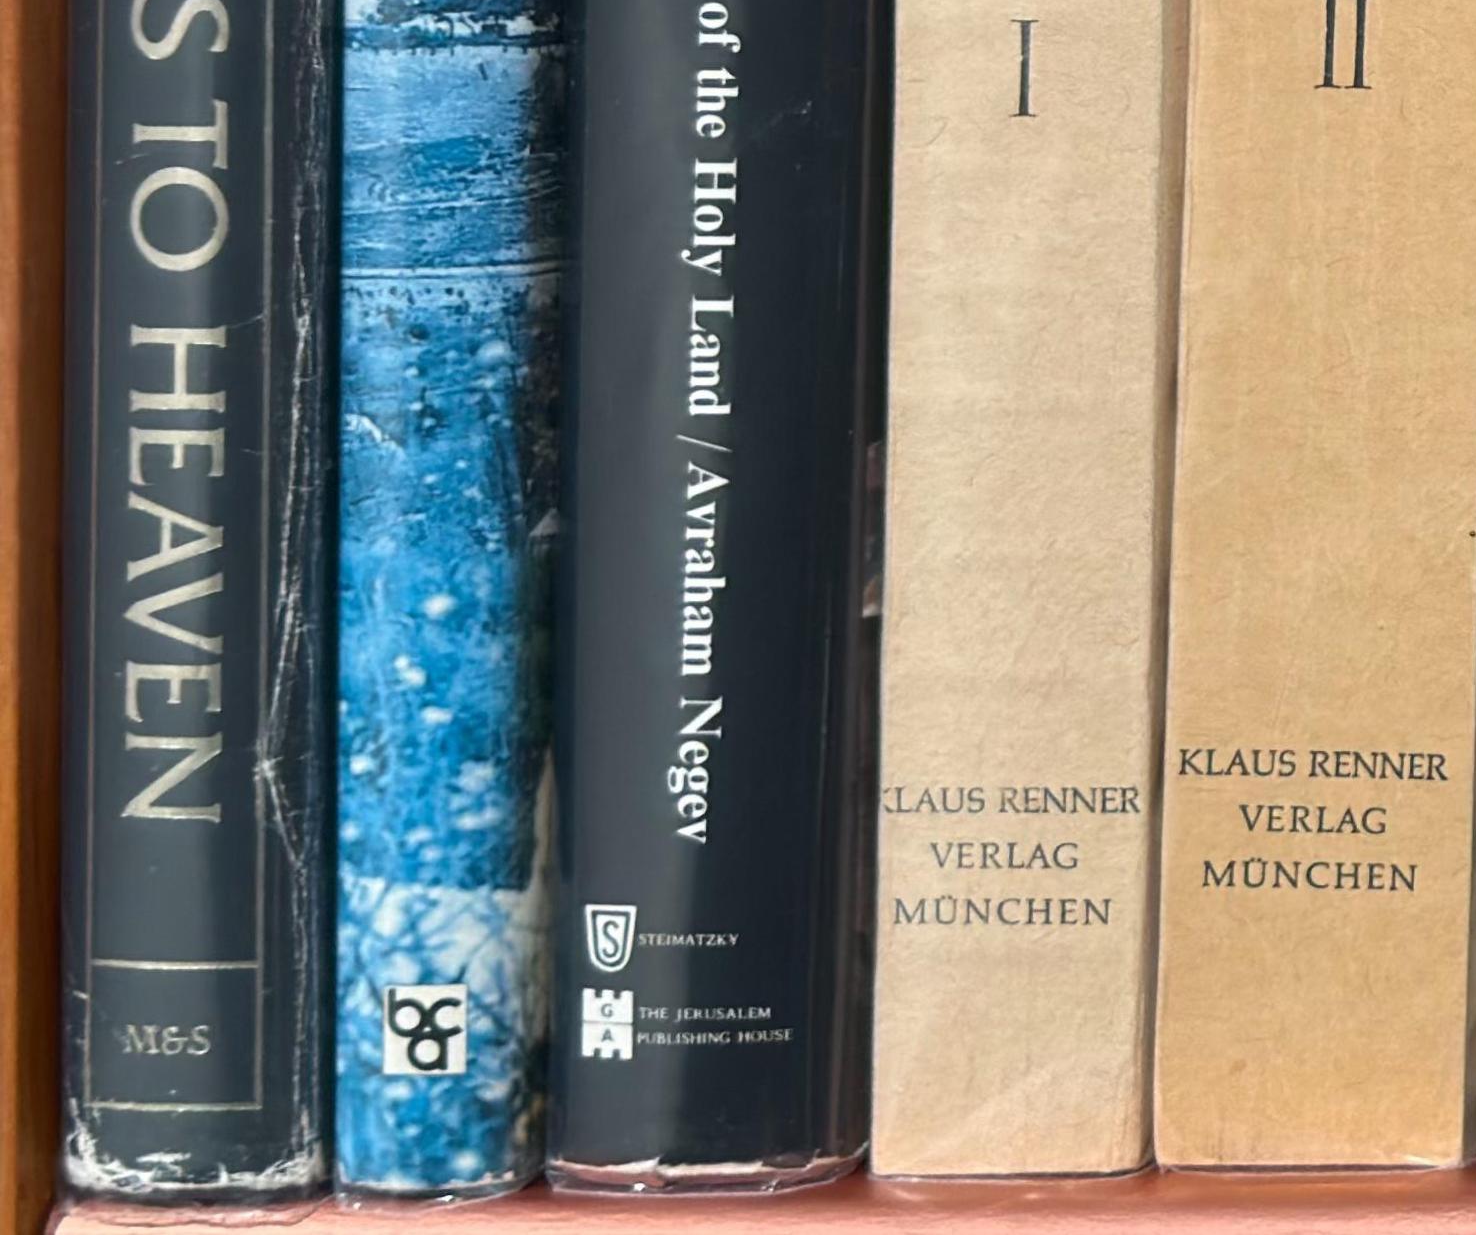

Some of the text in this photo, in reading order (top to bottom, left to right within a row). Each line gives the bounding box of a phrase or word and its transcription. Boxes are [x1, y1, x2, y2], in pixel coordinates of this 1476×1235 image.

[695, 1, 742, 53] of
[1010, 19, 1039, 117] I
[693, 67, 740, 140] the
[129, 101, 230, 271] TO
[682, 157, 738, 275] Holy
[688, 295, 735, 417] Land
[121, 325, 226, 824] HEAVEN
[681, 463, 731, 675] Avraham
[667, 695, 722, 845] Negev
[1178, 749, 1448, 781] KLAUS RENNER
[999, 786, 1140, 814] RENNER
[1238, 805, 1387, 834] VERLAG
[930, 842, 1079, 869] VERLAG
[1202, 858, 1418, 891] MÜNCHEN
[893, 895, 1111, 925] MÜNCHEN
[638, 933, 739, 946] STEIMATZKY
[639, 1007, 771, 1022] THE JERUSALEM
[122, 1023, 211, 1054] M&S
[637, 1029, 793, 1044] PUBLISHING HOUSE
